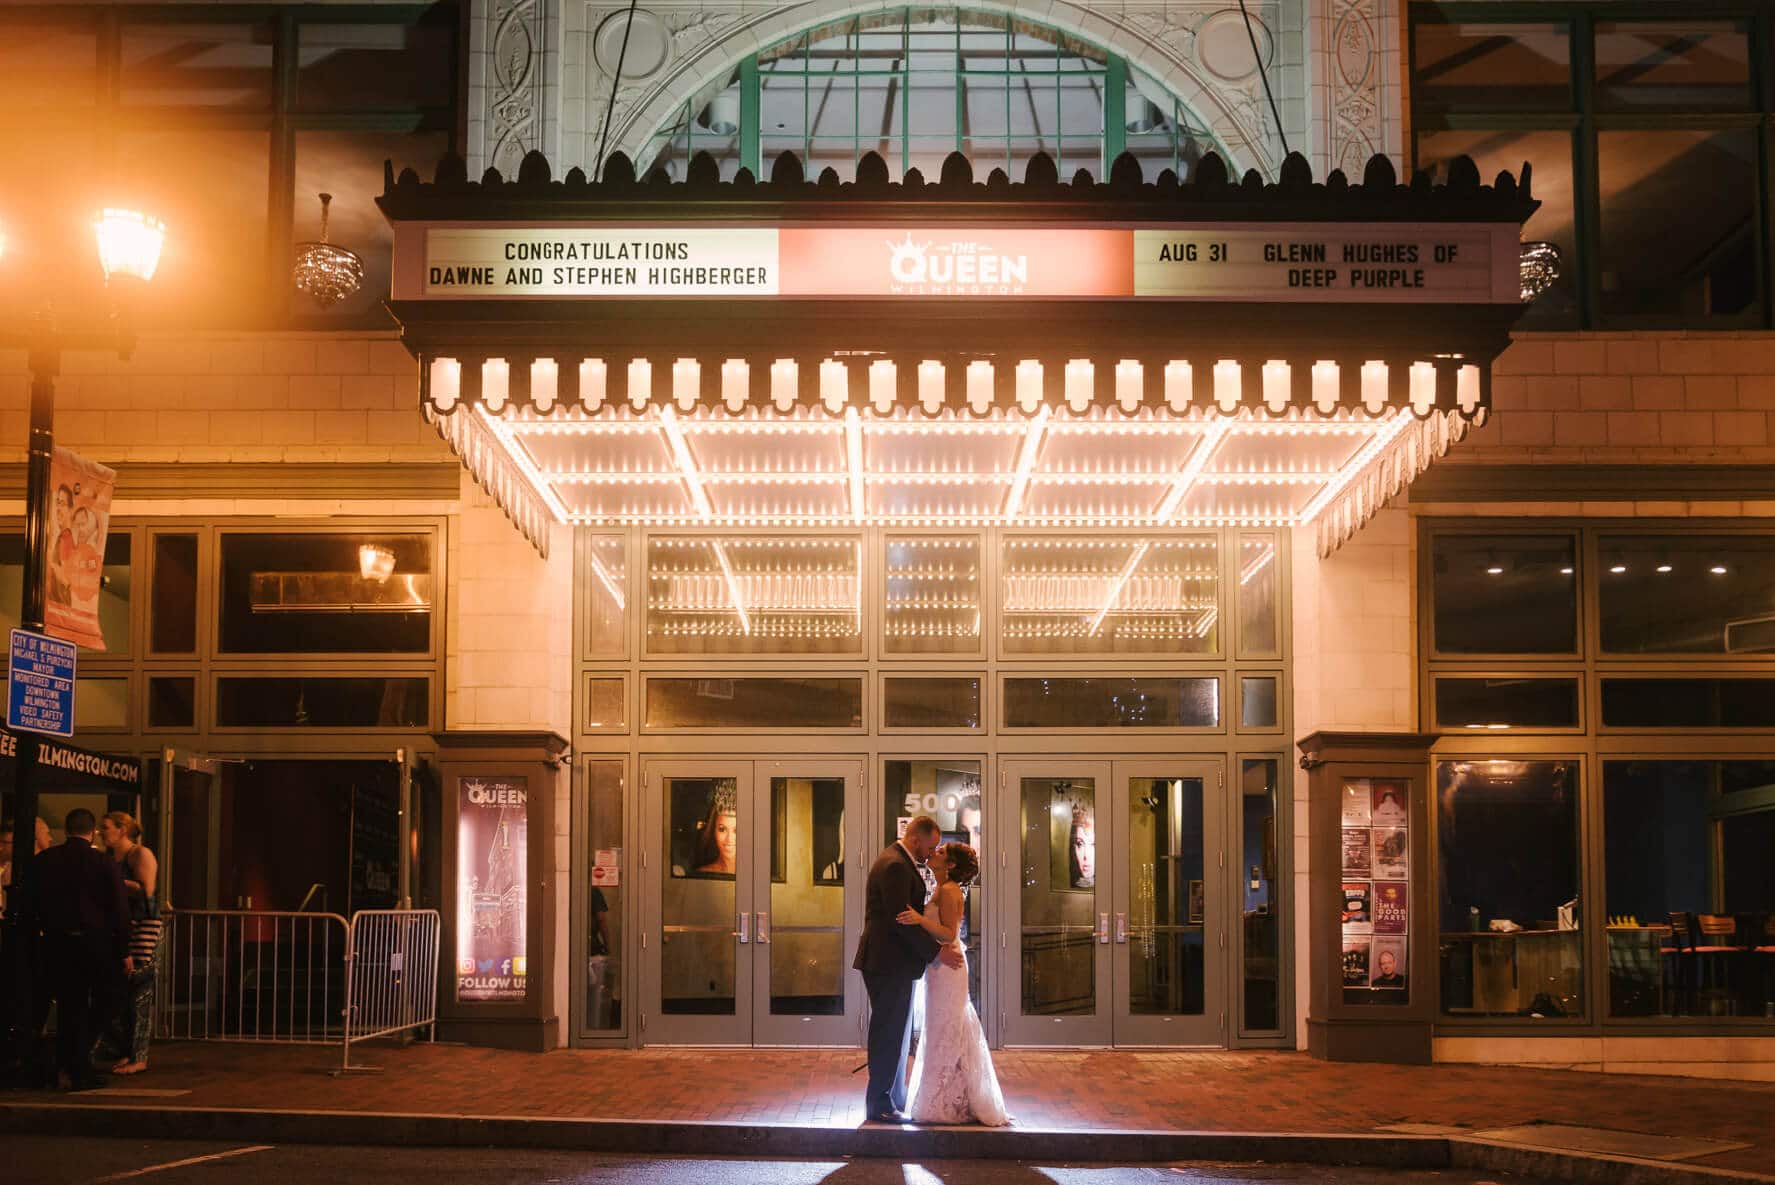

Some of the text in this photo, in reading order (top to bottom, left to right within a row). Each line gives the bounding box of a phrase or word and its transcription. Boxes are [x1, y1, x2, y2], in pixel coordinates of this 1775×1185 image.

[505, 242, 689, 260] CONGRATULATIONS
[951, 242, 977, 254] THE
[1159, 242, 1458, 263] AUG 31 GLENN HUGHES OF
[430, 266, 767, 285] DAWNE AND STEPHEN HIGHBERGER
[890, 254, 1027, 283] QUEEN
[1288, 269, 1424, 288] DEEP PURPLE
[13, 634, 75, 659] CITY OF WILMINGTON
[33, 662, 55, 675] MAYOR
[15, 671, 70, 692] MONITORED AREA
[25, 684, 60, 700] DOWNTOWN
[24, 695, 61, 711] WILMINGTON
[19, 705, 65, 722] VIDEO SAFETY
[20, 715, 63, 731] PARTNERSHIP
[0, 732, 17, 758] EE
[468, 788, 528, 804] QUEEN
[904, 793, 960, 814] 500
[458, 977, 510, 989] FOLLOW
